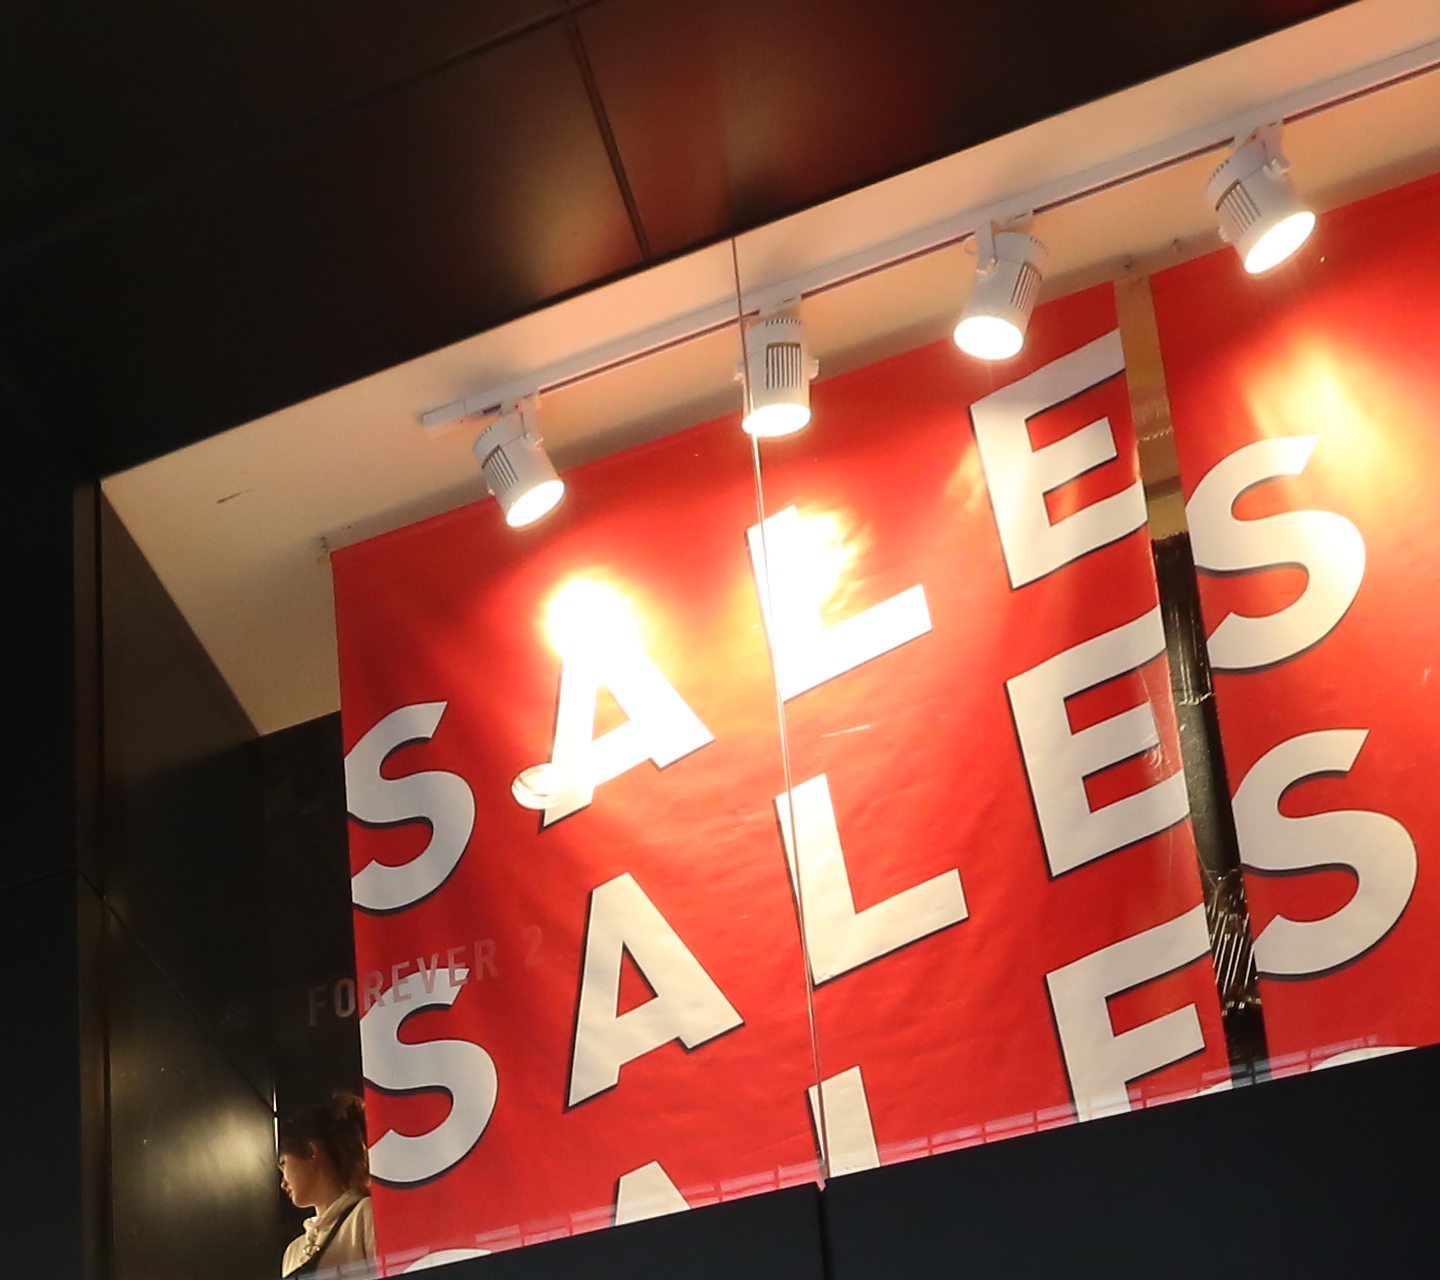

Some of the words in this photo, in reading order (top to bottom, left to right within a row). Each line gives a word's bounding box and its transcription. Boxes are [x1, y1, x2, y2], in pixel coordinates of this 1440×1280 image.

[343, 328, 1150, 911] SALE
[359, 605, 1192, 1185] SALE
[308, 937, 499, 1028] FOREVER
